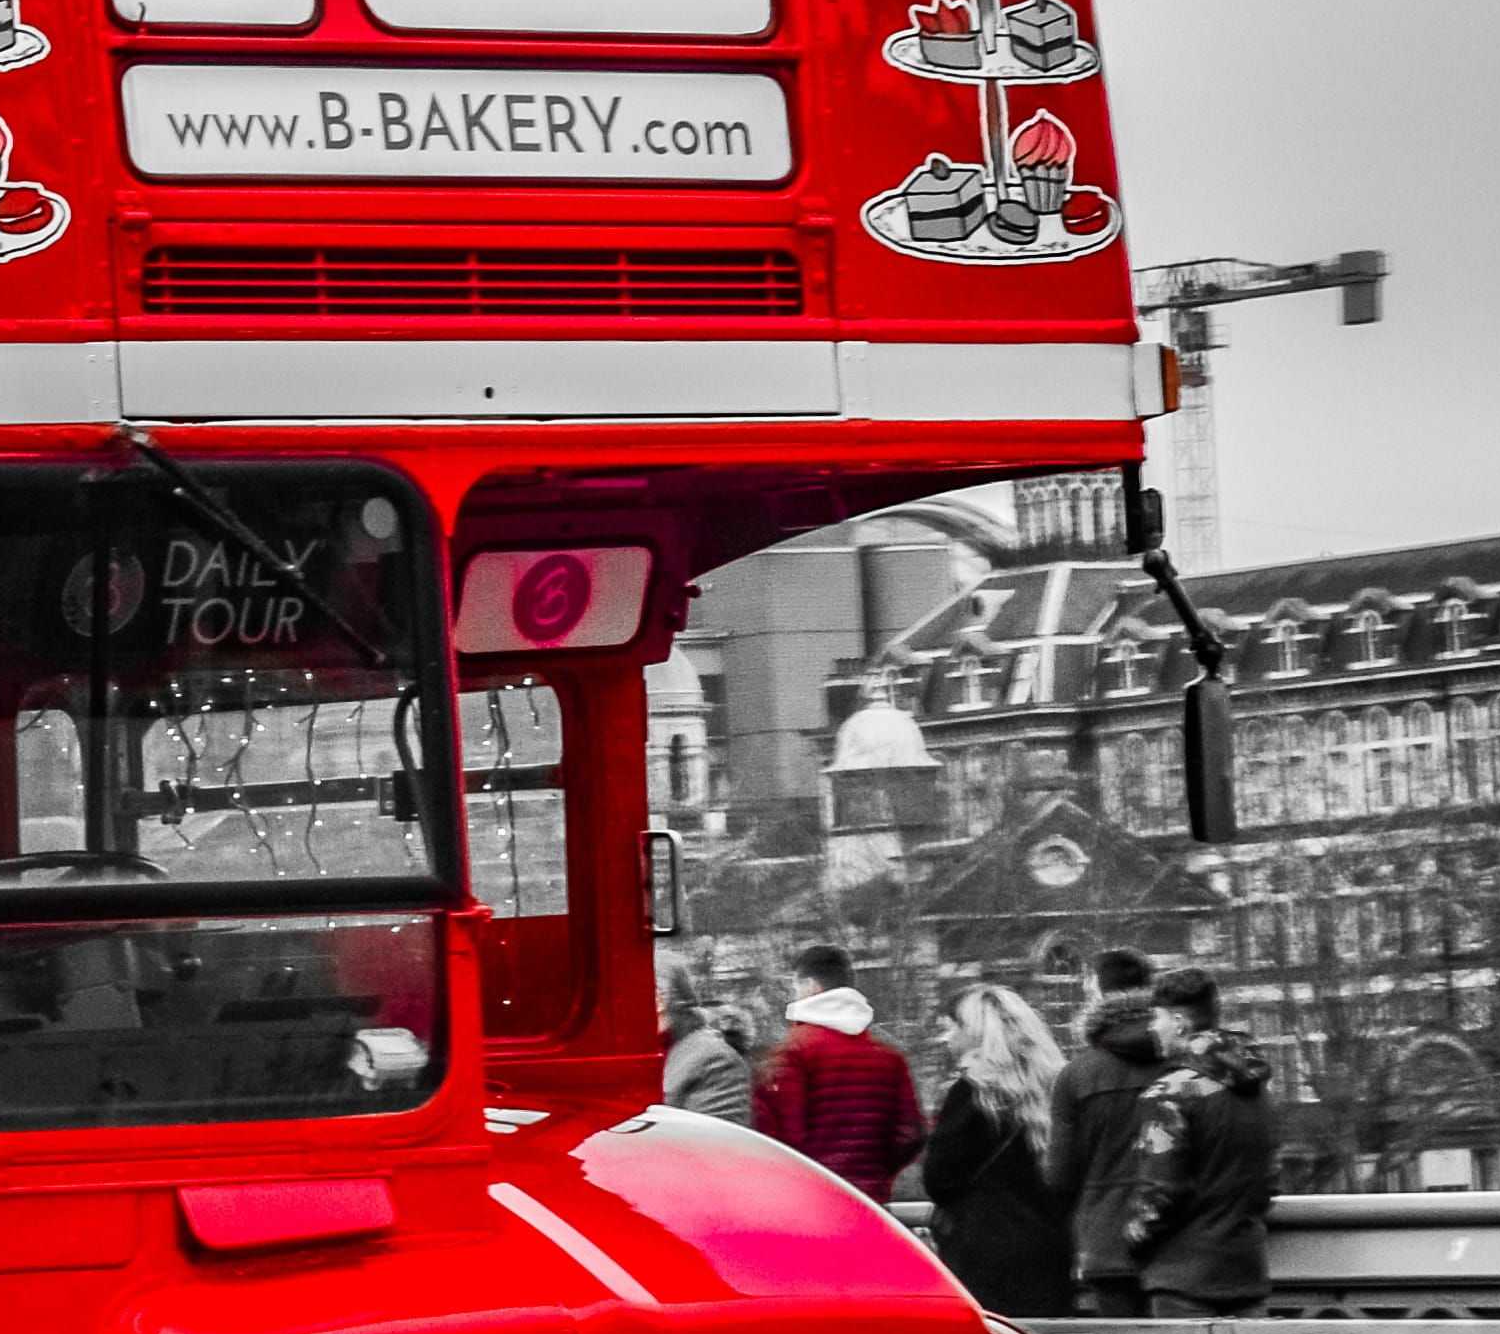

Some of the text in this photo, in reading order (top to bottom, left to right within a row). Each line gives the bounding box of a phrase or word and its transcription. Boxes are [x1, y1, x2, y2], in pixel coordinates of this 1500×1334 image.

[167, 91, 753, 157] www.B-BAKERY.com
[161, 538, 319, 587] DAILY
[161, 597, 305, 645] TOUR
